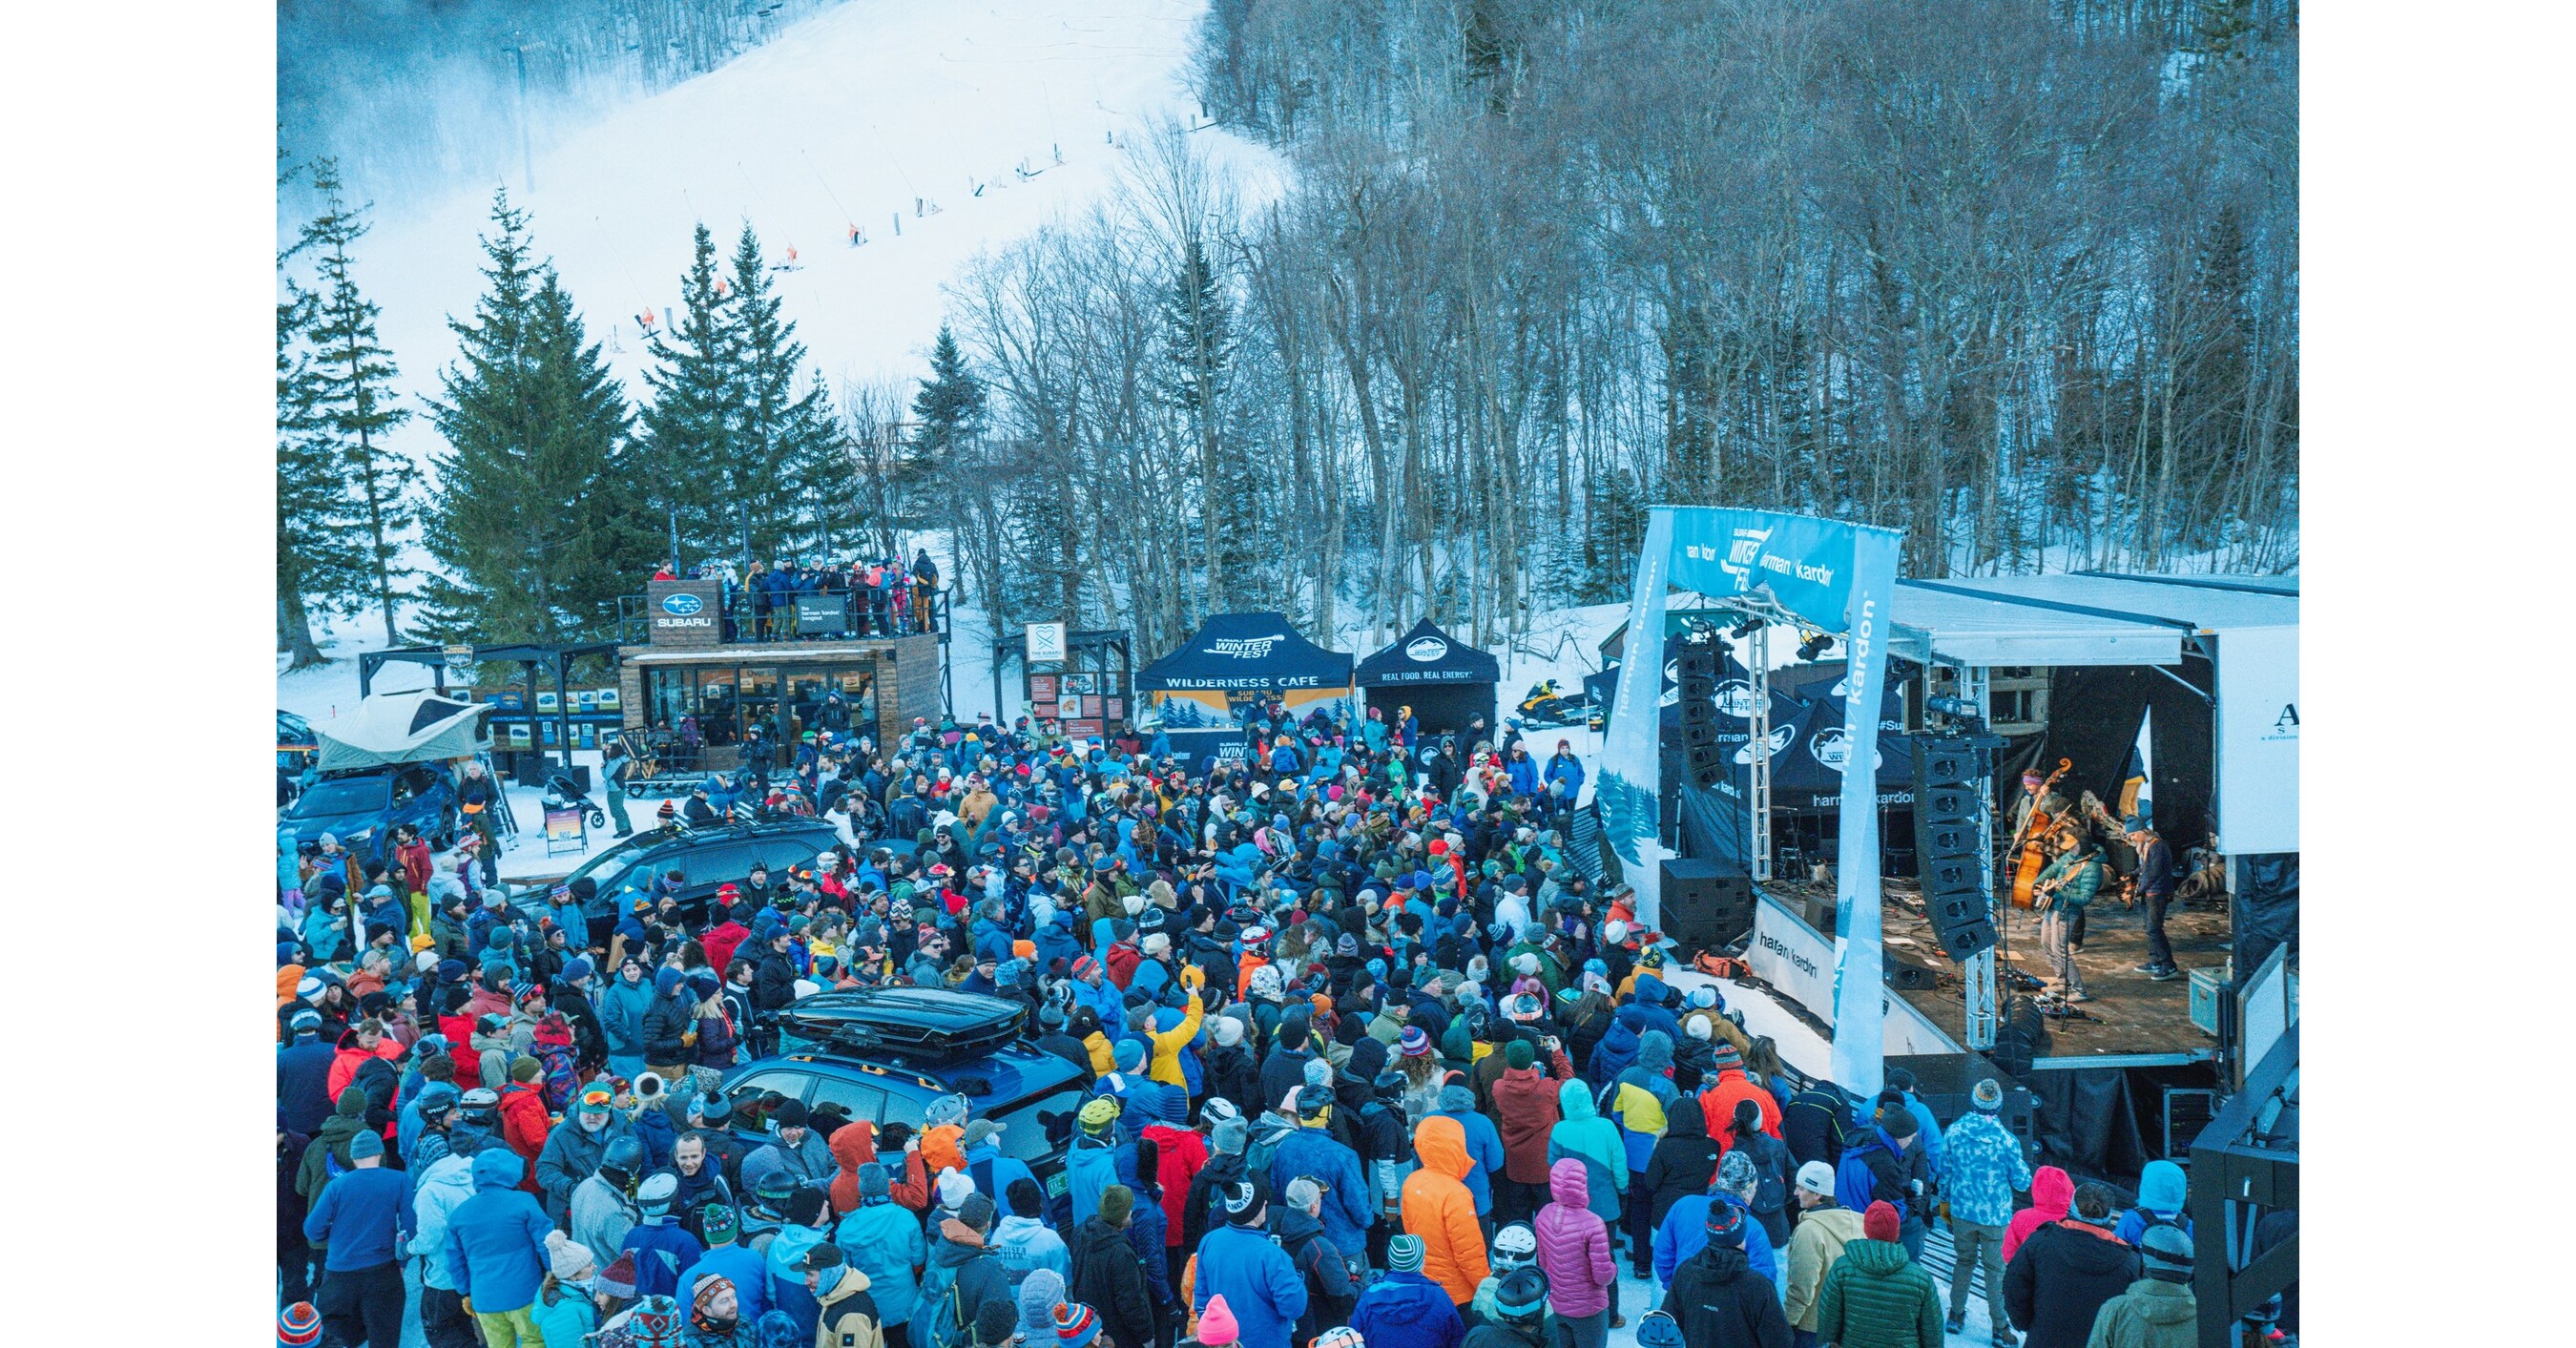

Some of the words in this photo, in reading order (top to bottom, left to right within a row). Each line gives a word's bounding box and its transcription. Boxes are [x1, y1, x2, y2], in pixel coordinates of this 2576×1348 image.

[657, 618, 711, 627] SUBARU
[1215, 640, 1273, 651] WINTER
[1233, 649, 1272, 659] FEST
[1847, 599, 1876, 705] kardon
[1166, 677, 1270, 688] WILDERNESS
[1278, 675, 1319, 687] CAFE
[1382, 673, 1400, 681] REAL
[1402, 672, 1422, 680] FOOD.
[1717, 734, 1749, 742] rman
